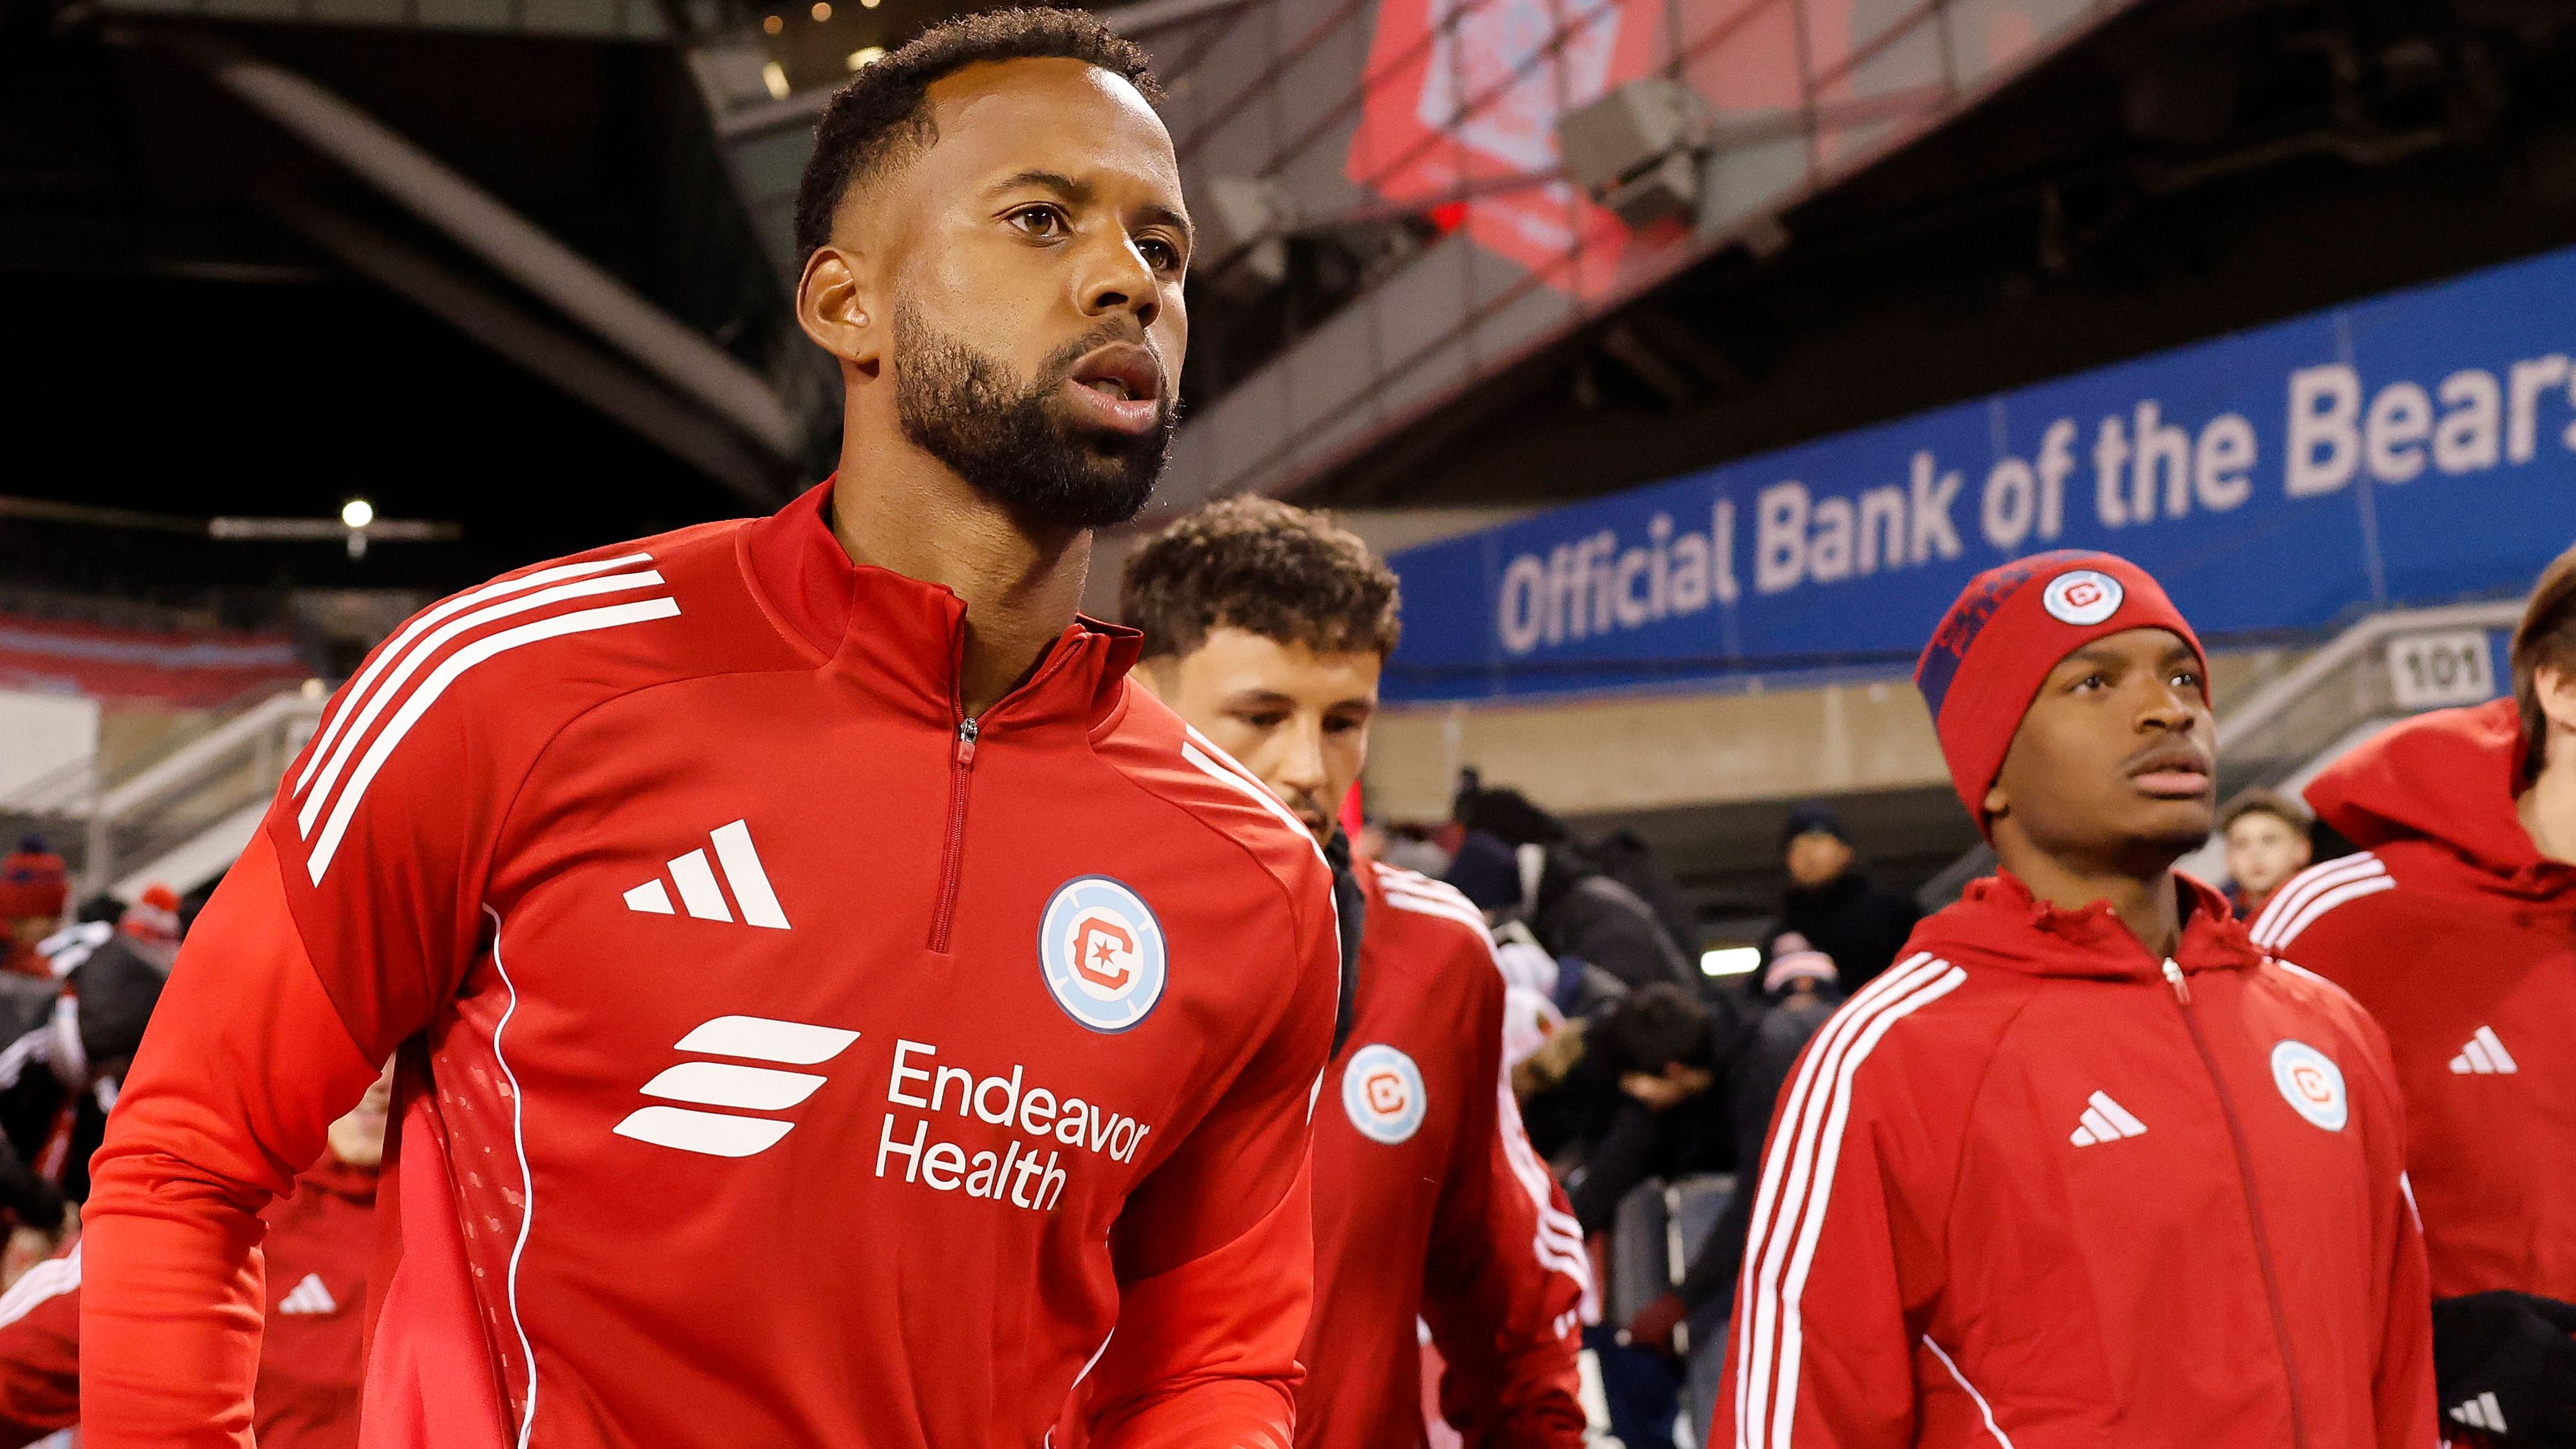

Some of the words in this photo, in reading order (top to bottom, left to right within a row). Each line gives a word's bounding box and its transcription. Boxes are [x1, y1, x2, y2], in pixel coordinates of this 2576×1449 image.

[1500, 499, 1740, 654] Official
[1756, 450, 1964, 594] Bank
[1981, 417, 2077, 549] of
[2095, 397, 2257, 528] the
[2406, 645, 2479, 690] 101
[1073, 916, 1133, 990] C
[887, 1038, 1151, 1163] Endeavor
[1367, 1072, 1404, 1114] C
[875, 1113, 1067, 1211] Health
